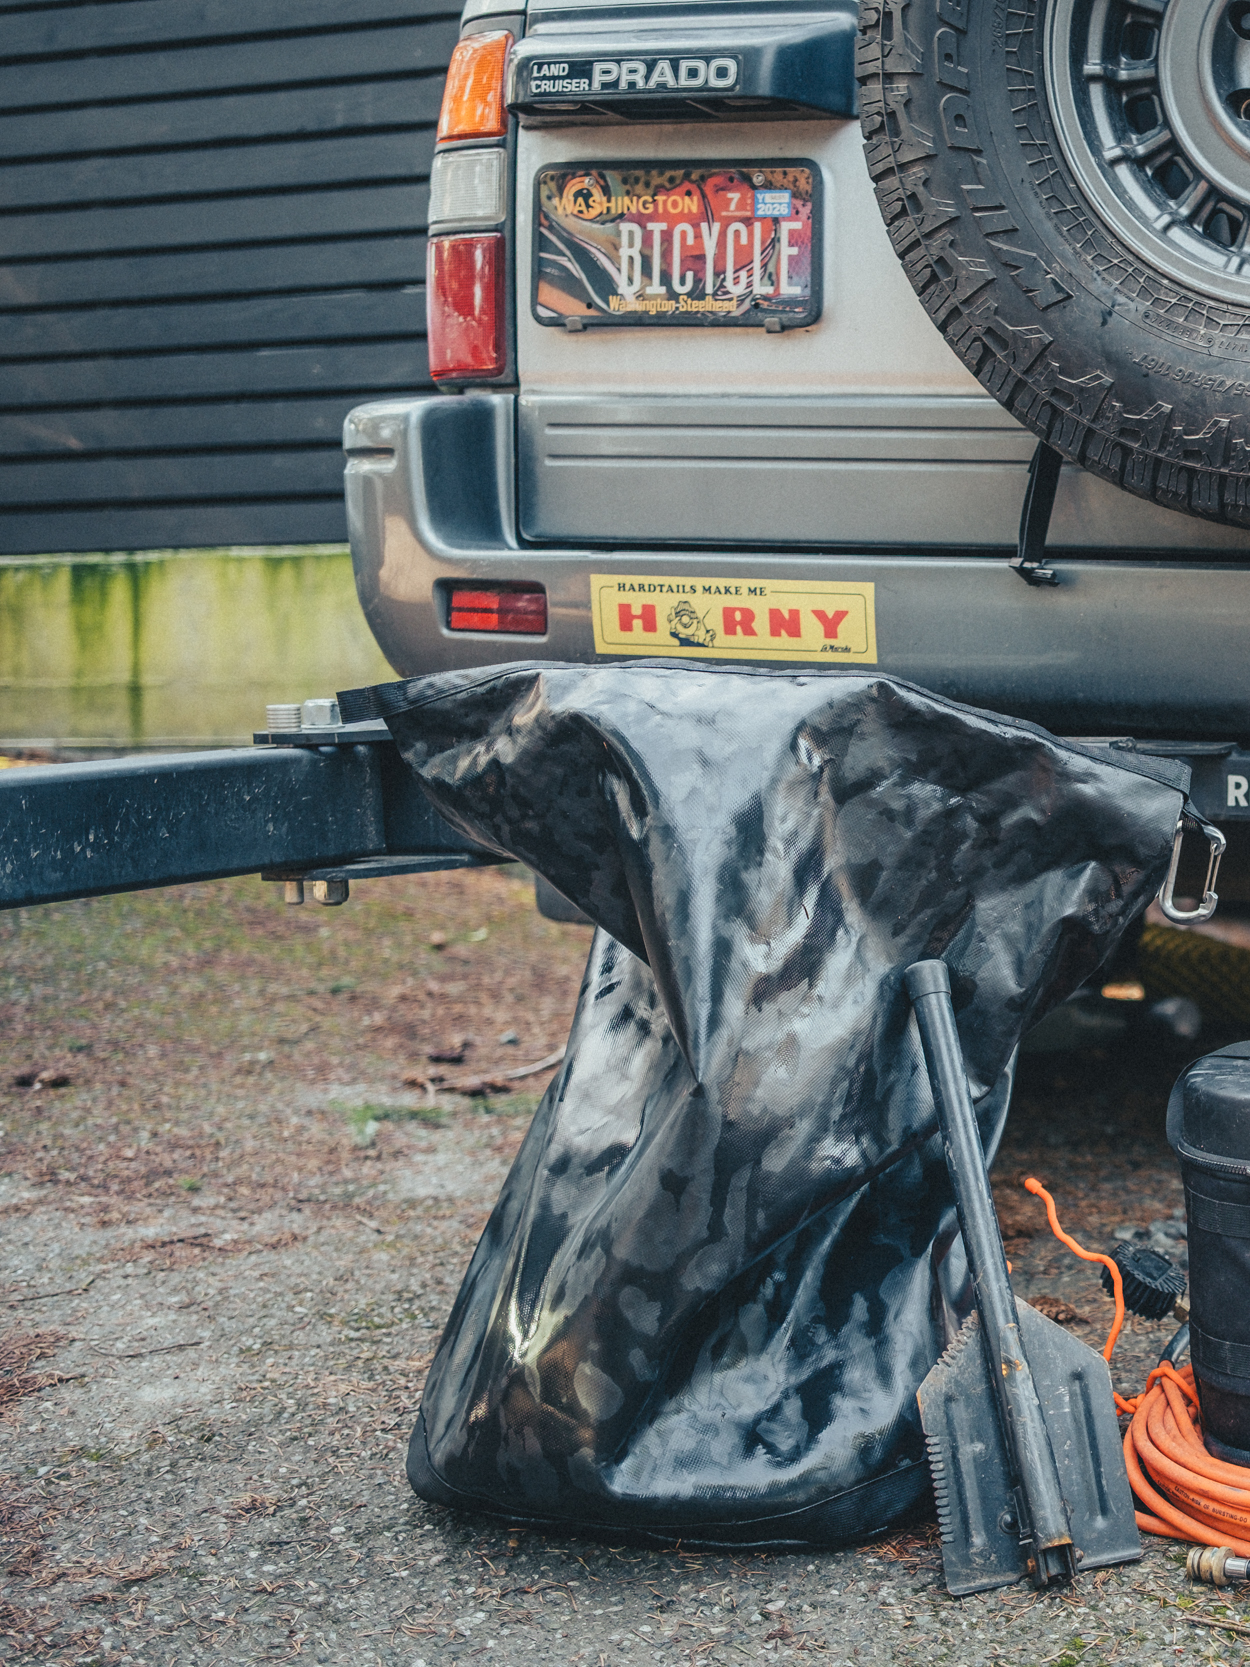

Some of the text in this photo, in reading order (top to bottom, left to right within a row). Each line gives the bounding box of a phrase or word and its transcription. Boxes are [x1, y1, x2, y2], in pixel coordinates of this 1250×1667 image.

[532, 63, 569, 77] LAND
[591, 58, 738, 91] PRADO
[531, 78, 590, 93] CRUISER
[555, 195, 698, 215] WASHINGTON
[727, 193, 741, 211] 7
[756, 203, 788, 215] 2026
[618, 221, 803, 295] BICYCLE
[609, 295, 737, 315] Washington Steelhead
[617, 582, 767, 596] HARDTAILS MAKE ME
